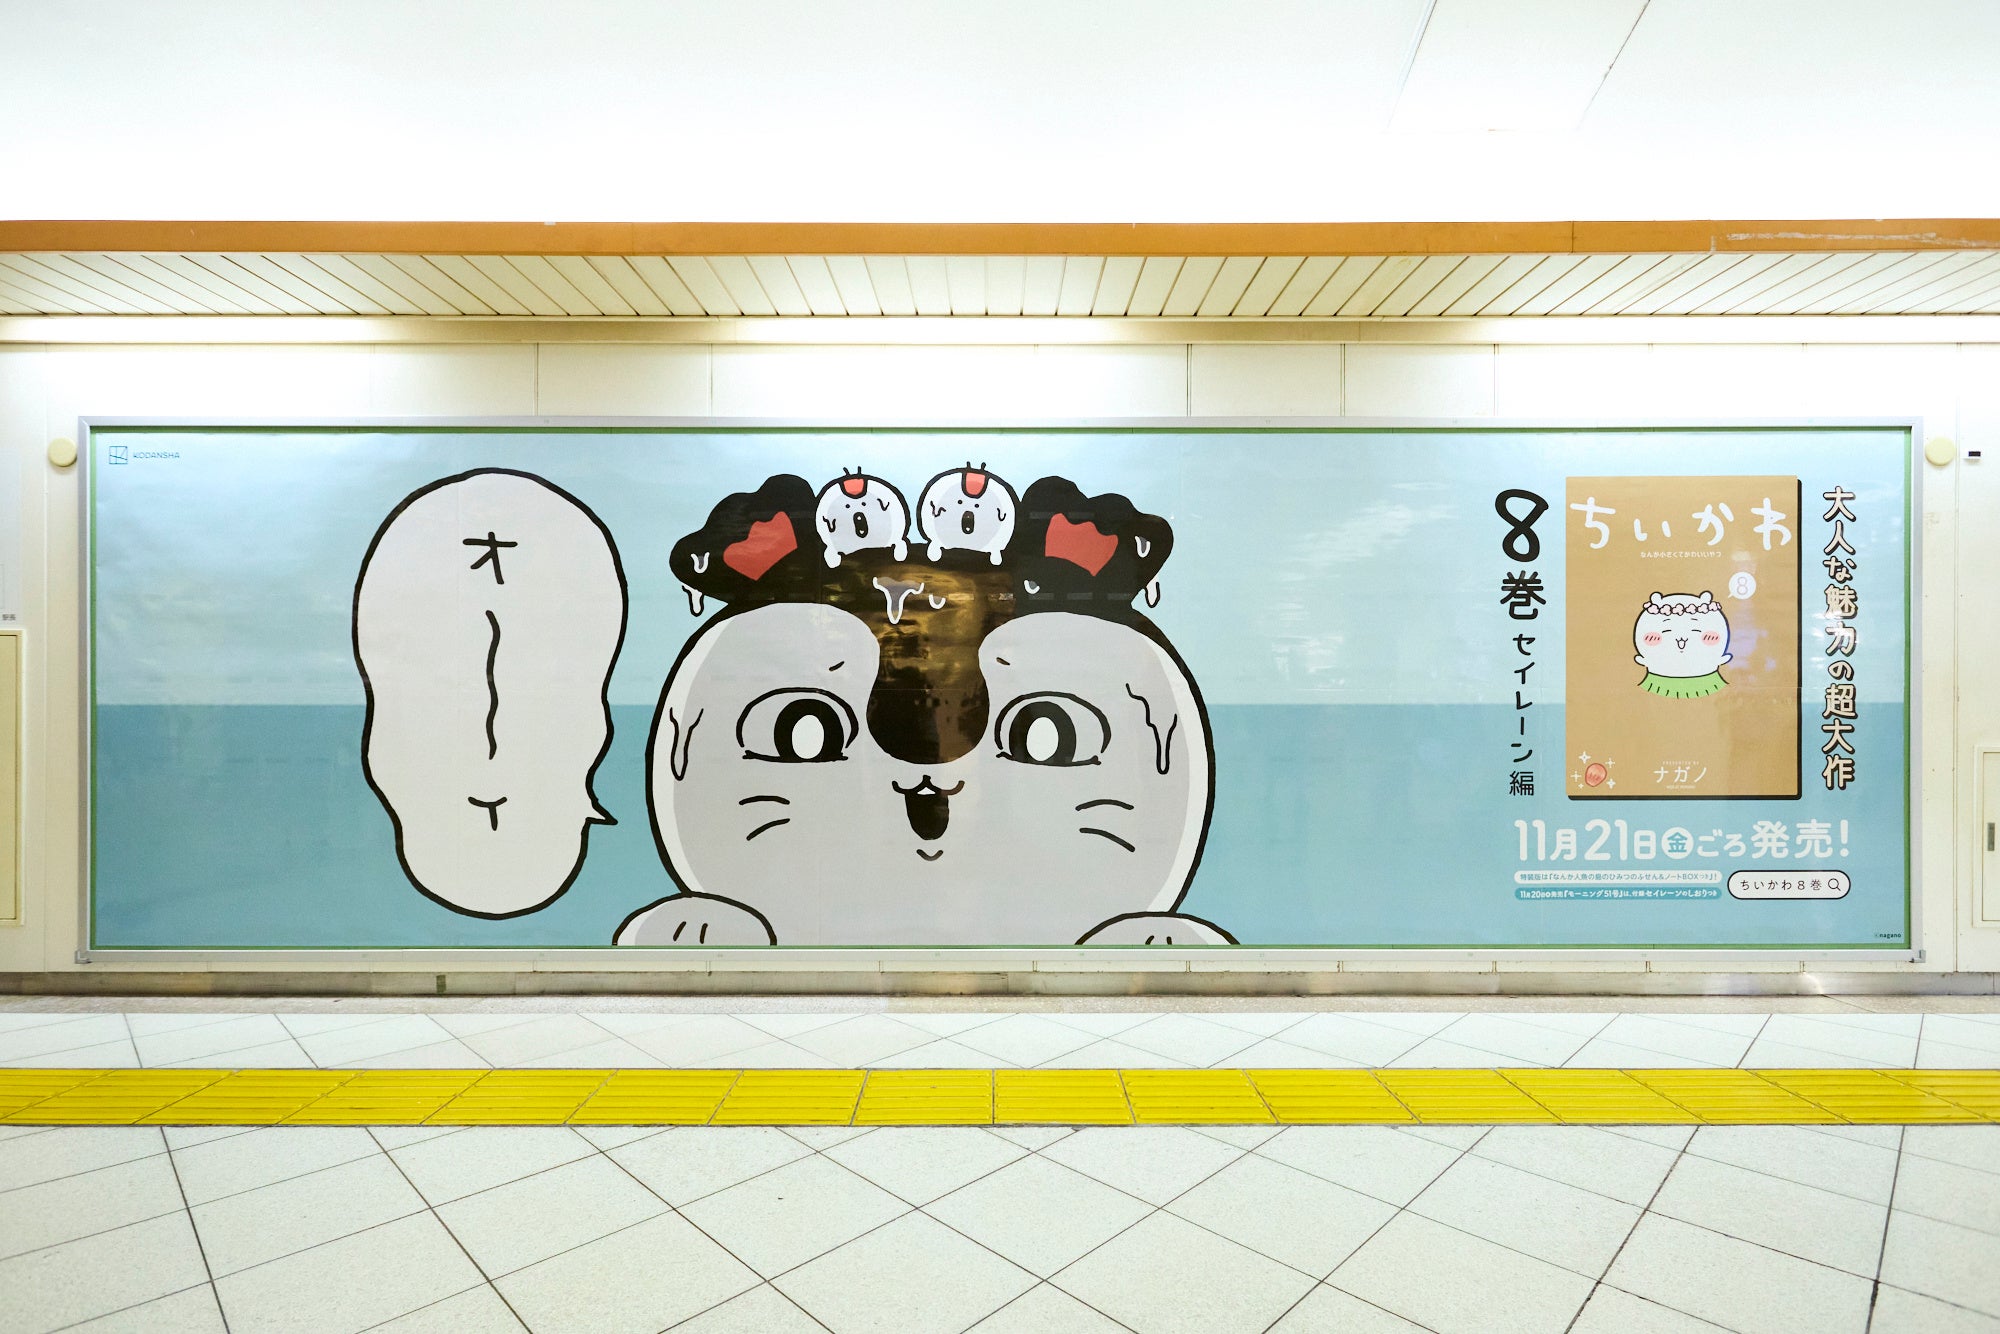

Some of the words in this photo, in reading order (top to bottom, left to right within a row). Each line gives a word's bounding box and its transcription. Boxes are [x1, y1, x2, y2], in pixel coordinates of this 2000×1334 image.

[133, 451, 180, 459] KODANSHA
[1569, 496, 1793, 551] ちいかわ
[1640, 551, 1722, 559] なんか小さくてかわいいやつ
[1736, 576, 1749, 596] 8
[1821, 485, 1858, 791] 大人な魅力の超大作
[1653, 766, 1708, 783] ナガノ
[1740, 879, 1823, 892] ちいかわ8巻
